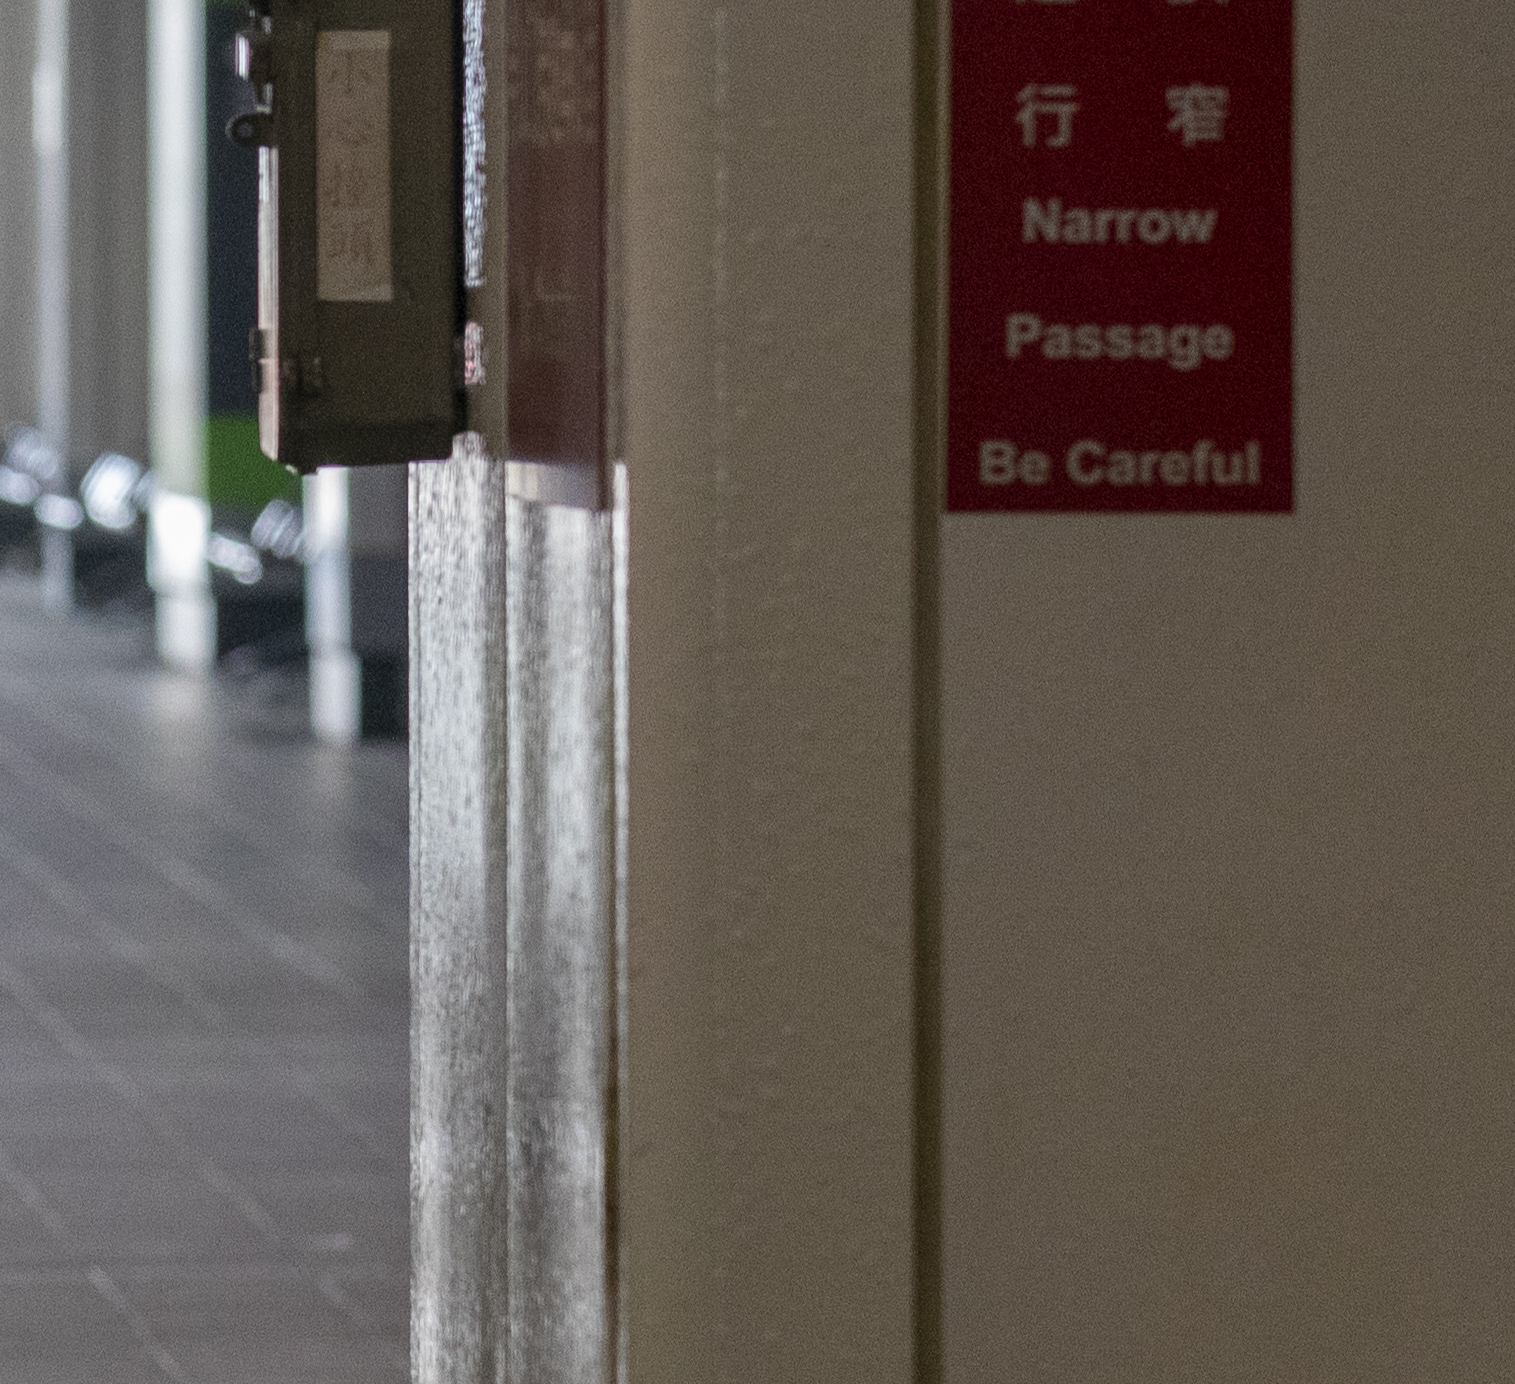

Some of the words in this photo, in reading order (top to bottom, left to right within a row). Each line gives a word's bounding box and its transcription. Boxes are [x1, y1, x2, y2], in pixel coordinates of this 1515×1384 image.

[1022, 197, 1217, 245] Narrow
[1005, 312, 1234, 370] Passage
[978, 439, 1049, 486] Be
[1066, 439, 1260, 486] Careful
